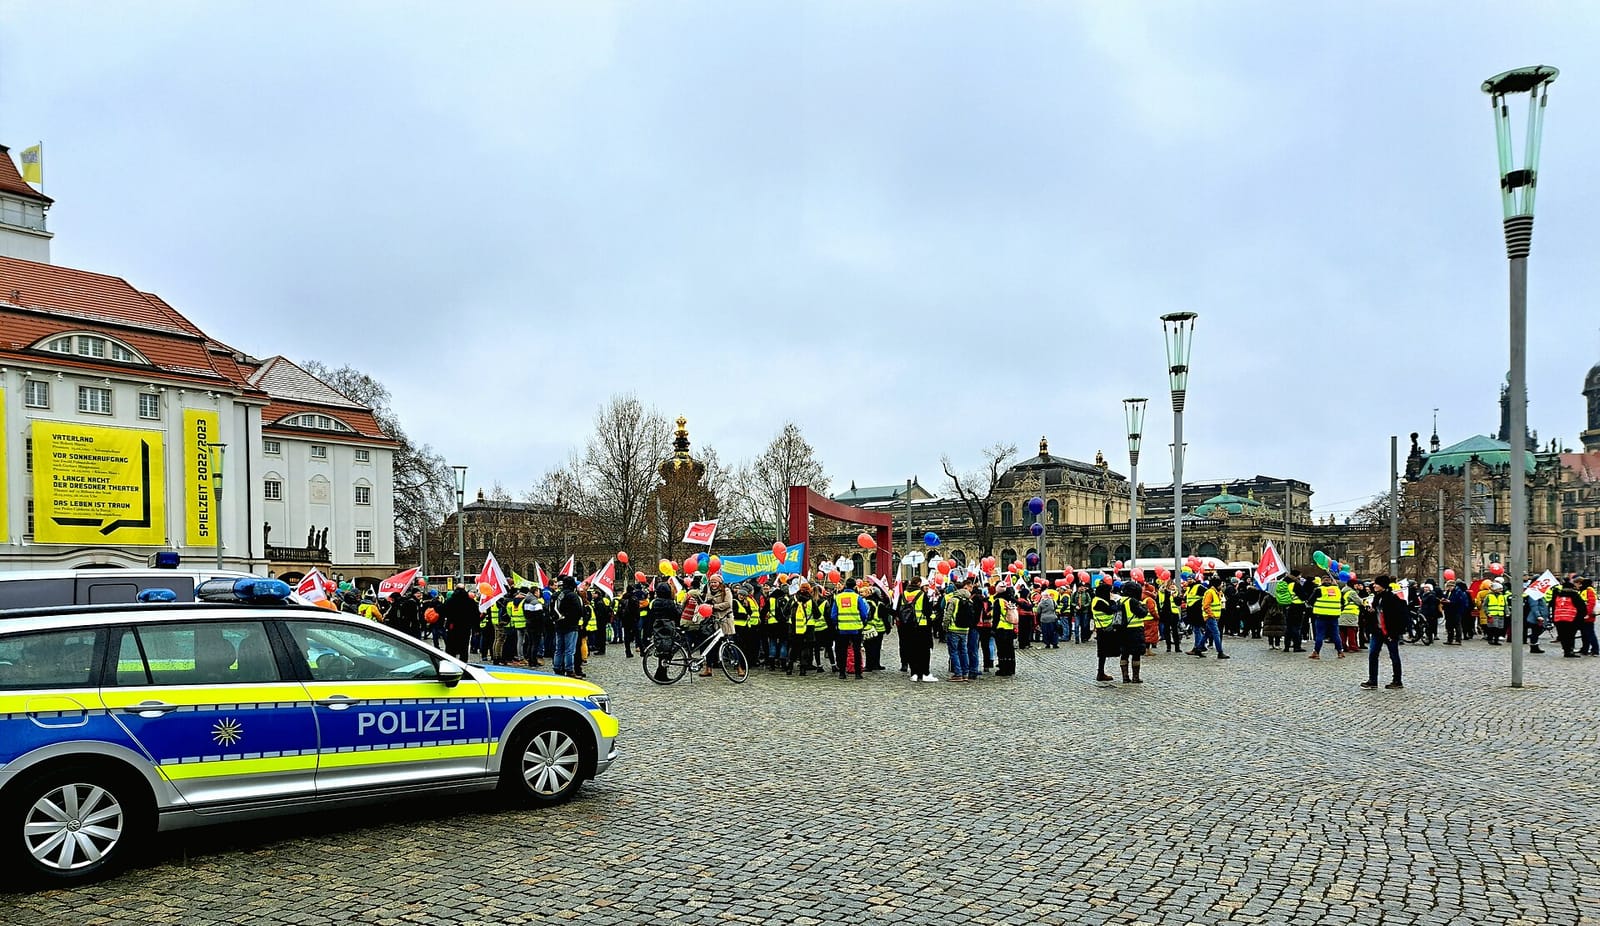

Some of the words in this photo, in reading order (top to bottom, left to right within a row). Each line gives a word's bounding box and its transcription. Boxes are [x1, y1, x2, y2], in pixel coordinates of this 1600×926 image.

[52, 434, 93, 443] VATERLAND
[197, 419, 207, 481] 2022/2023
[69, 454, 128, 463] SONNENAUFGANG
[198, 485, 208, 537] SPIELZEIT
[358, 708, 465, 736] POLIZEI
